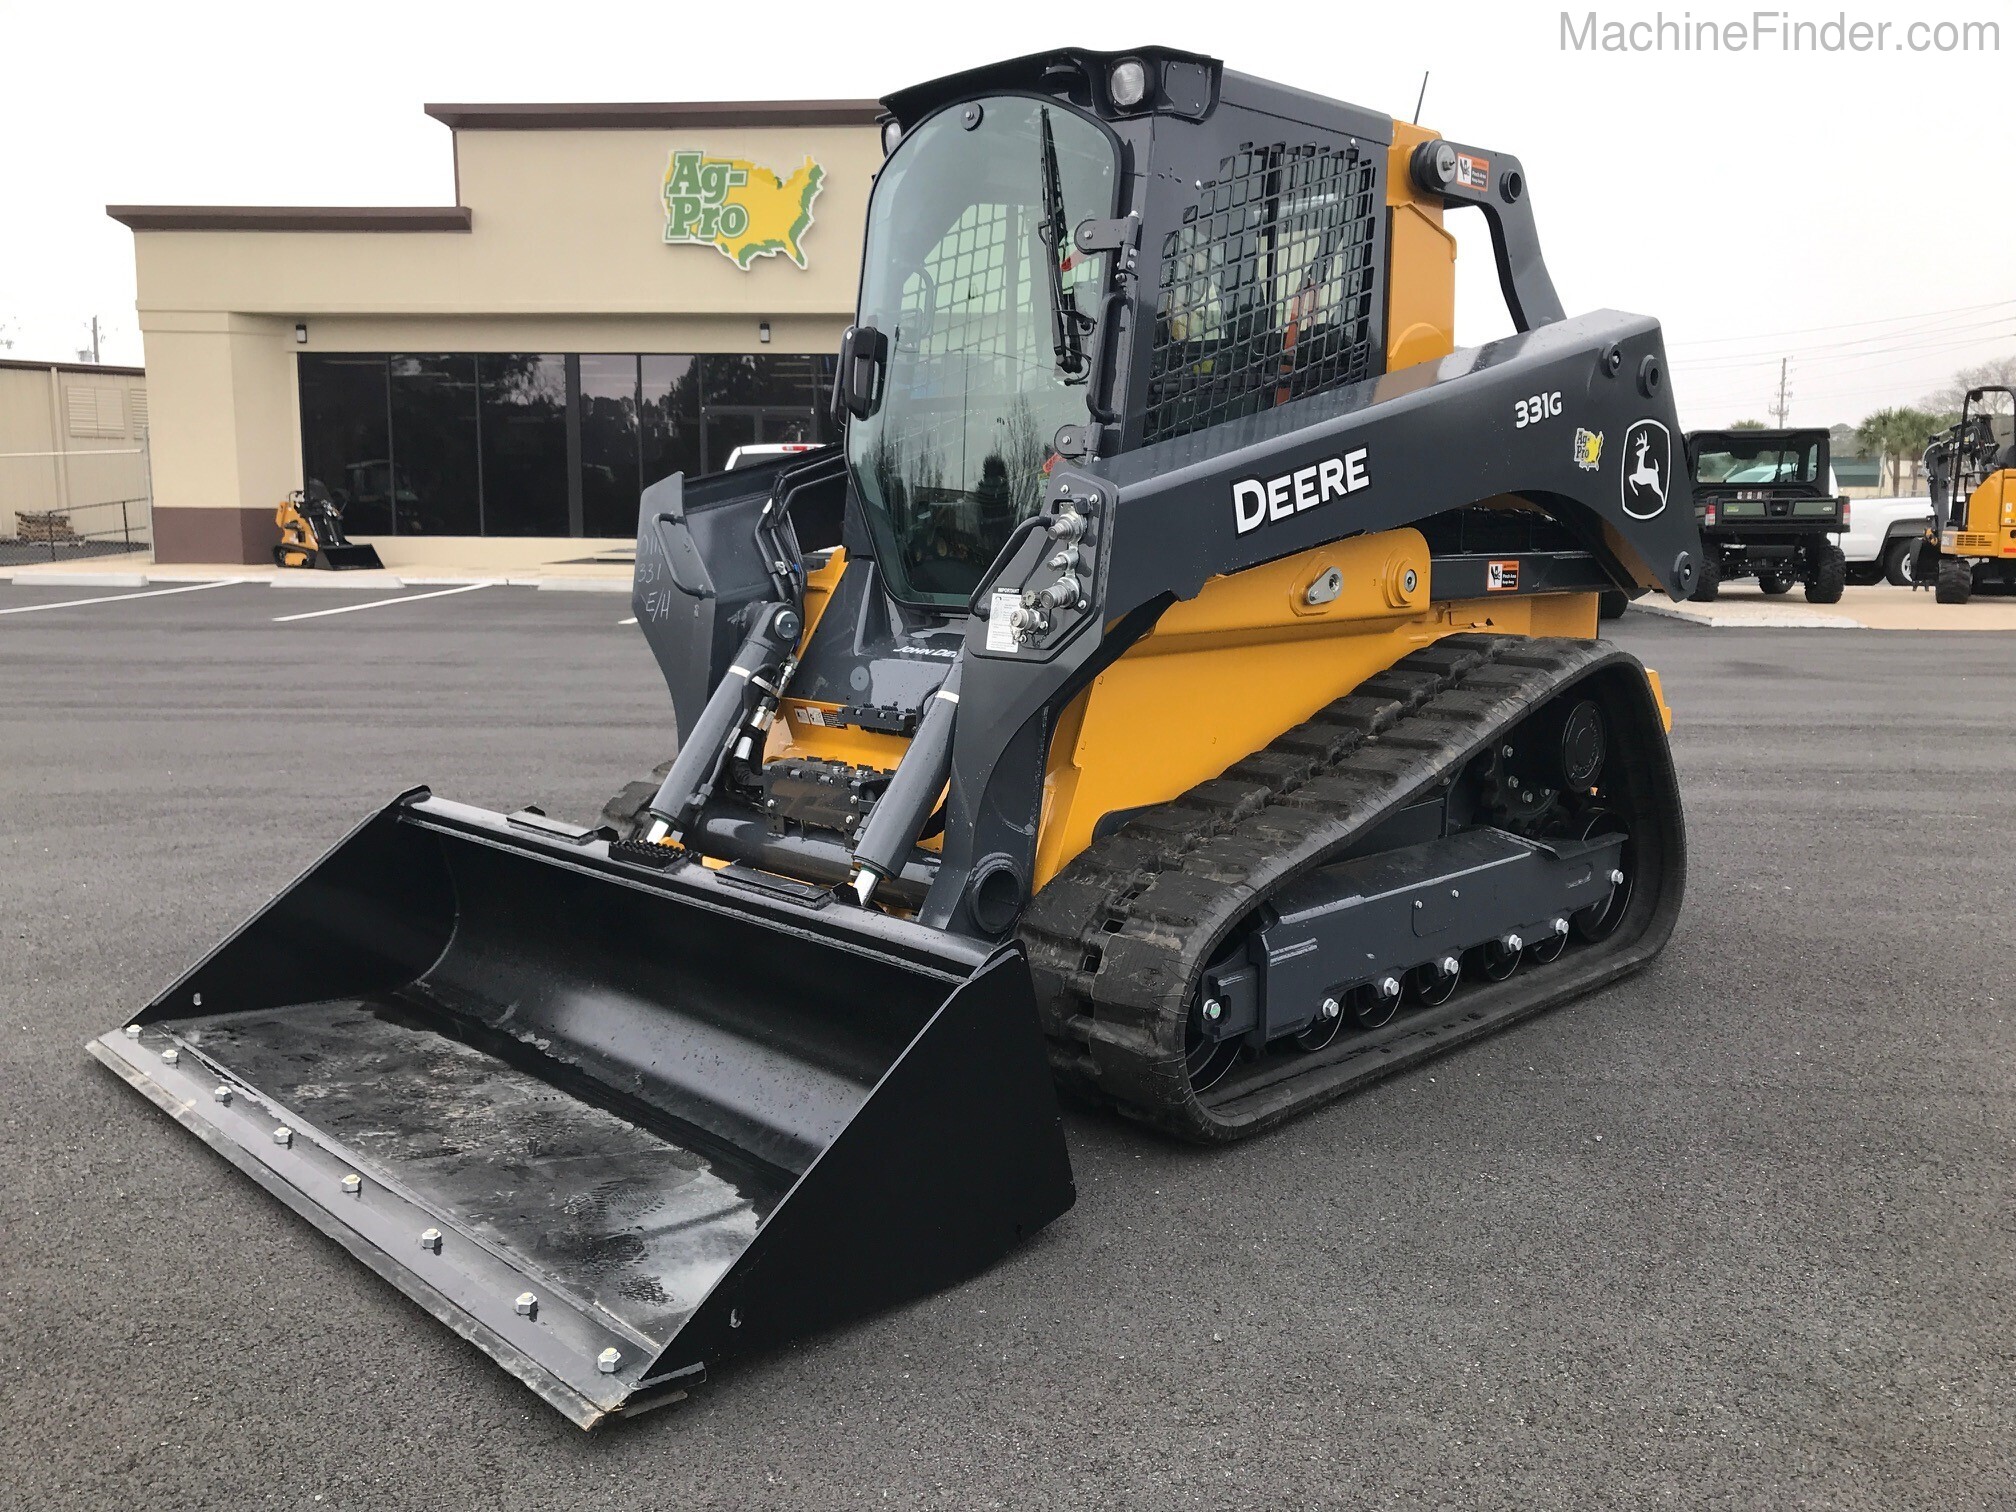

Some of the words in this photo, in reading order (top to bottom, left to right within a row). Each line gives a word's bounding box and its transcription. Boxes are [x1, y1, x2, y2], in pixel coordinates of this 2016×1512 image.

[664, 151, 749, 205] Ag-
[665, 195, 749, 241] Pro
[1514, 391, 1563, 429] 331G
[1576, 445, 1590, 459] Pro
[1233, 448, 1370, 534] DEERE
[638, 563, 662, 583] 331
[893, 645, 935, 655] JOHN
